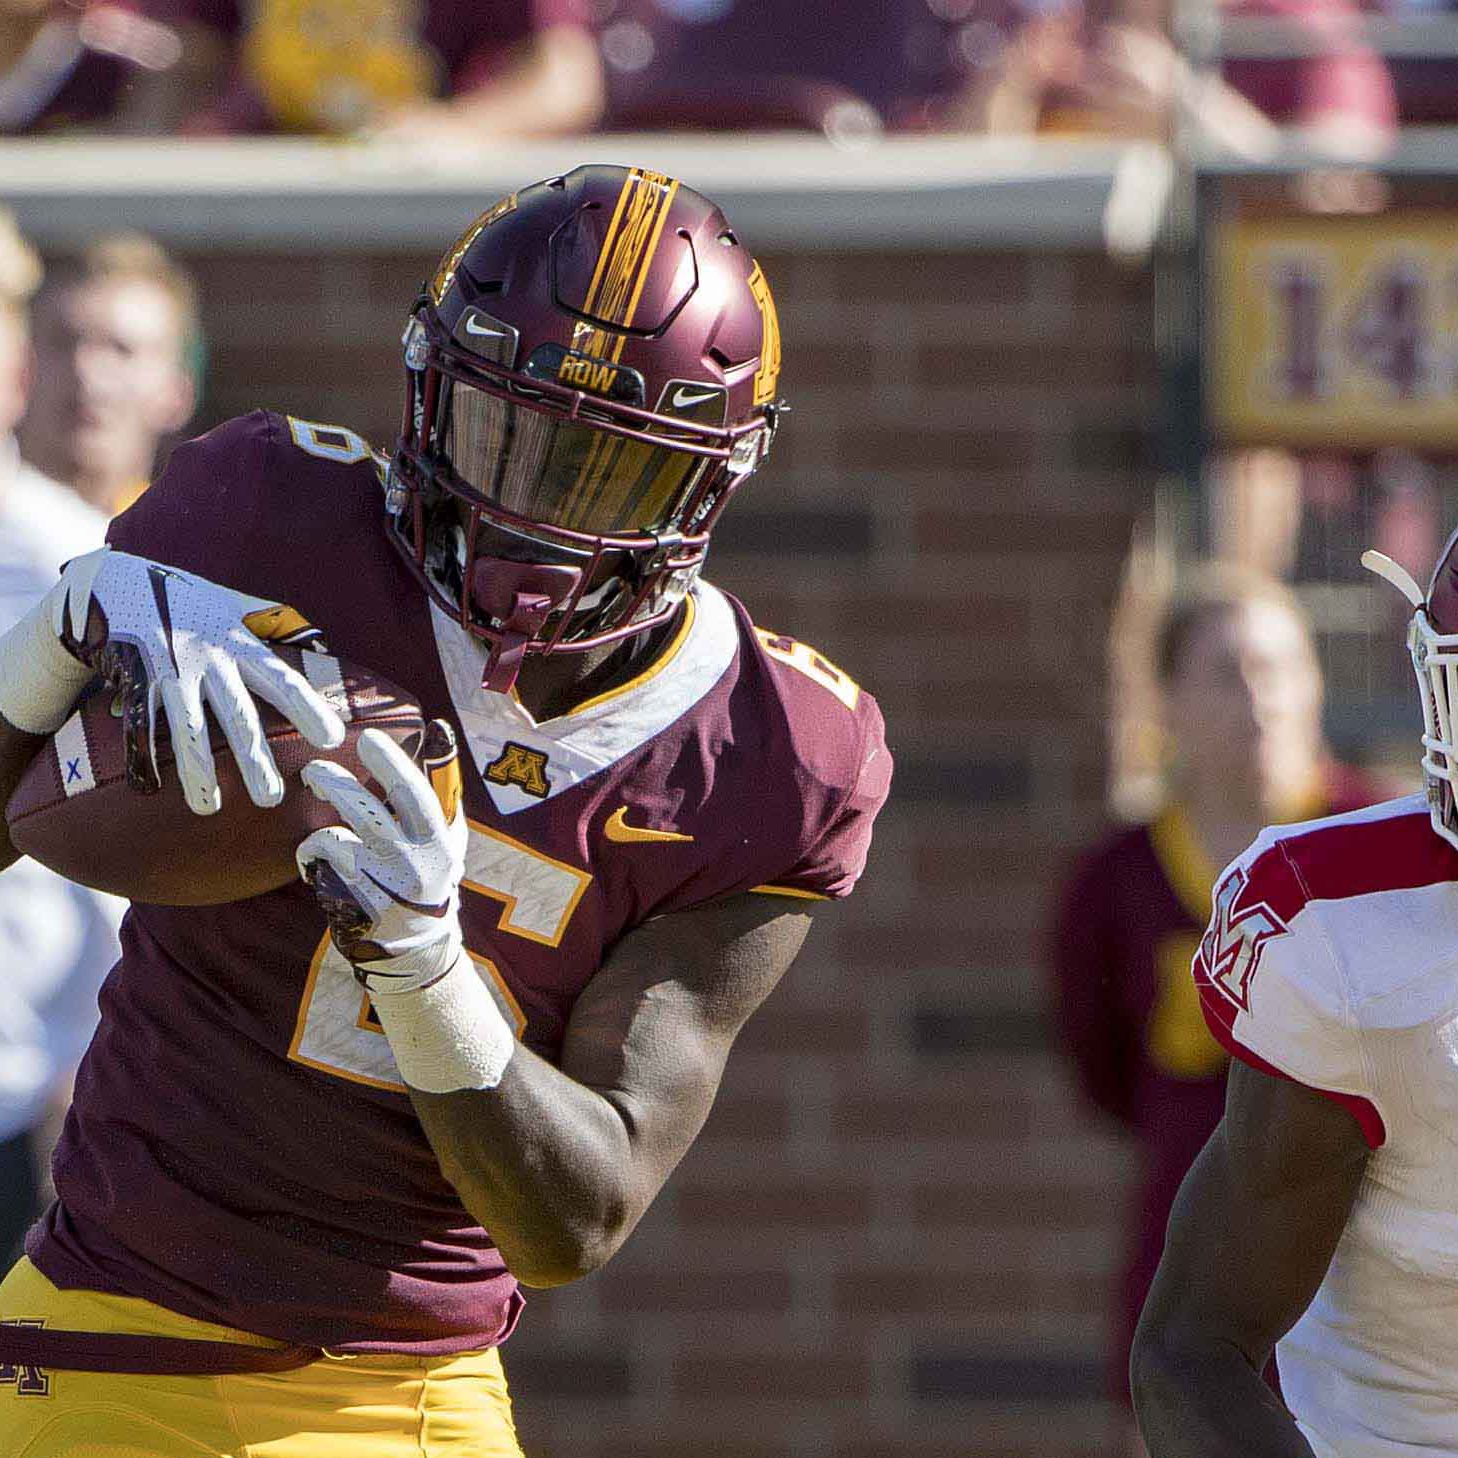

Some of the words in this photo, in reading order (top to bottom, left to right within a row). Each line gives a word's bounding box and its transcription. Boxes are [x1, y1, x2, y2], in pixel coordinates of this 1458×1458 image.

[558, 354, 618, 393] ROW
[66, 757, 83, 784] X
[483, 741, 551, 799] M
